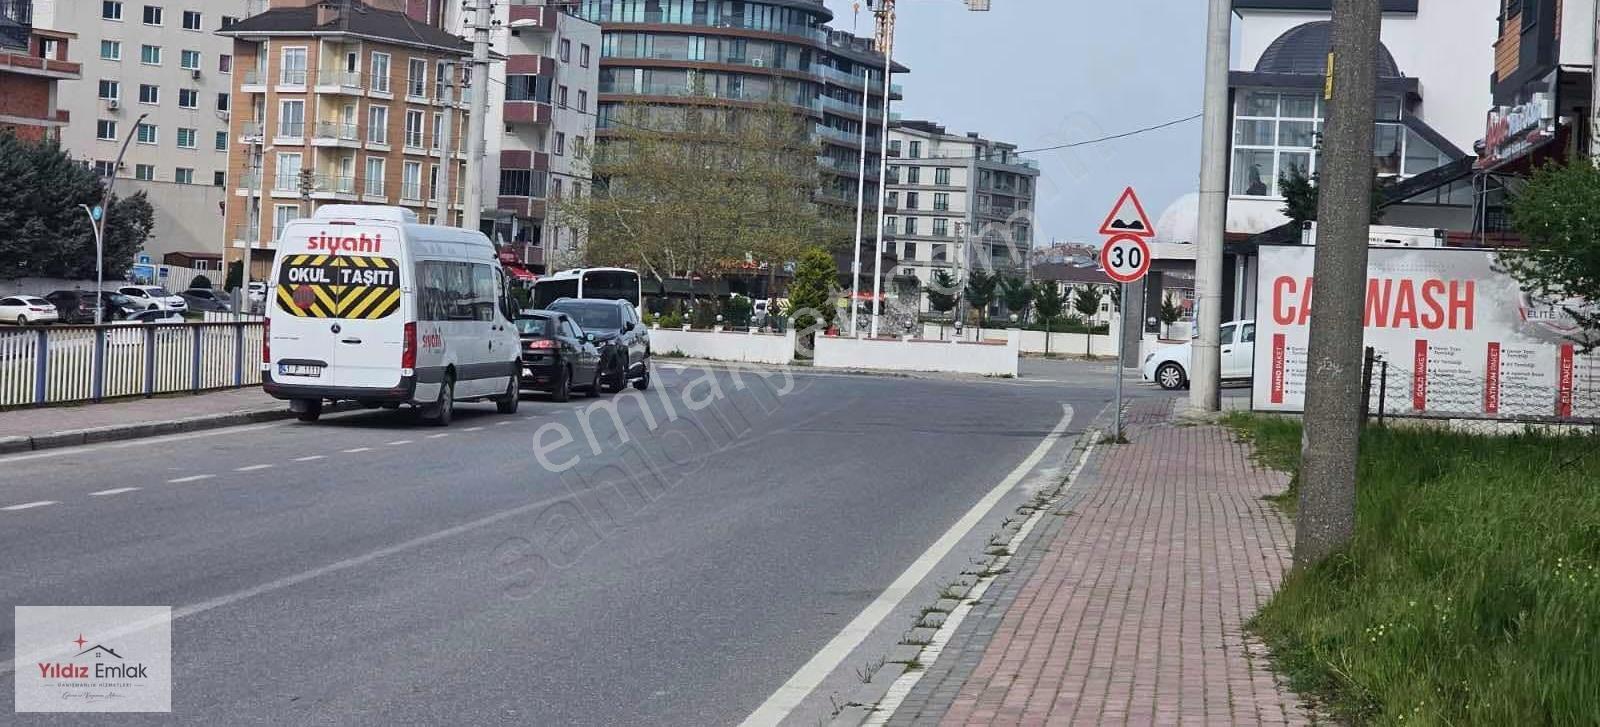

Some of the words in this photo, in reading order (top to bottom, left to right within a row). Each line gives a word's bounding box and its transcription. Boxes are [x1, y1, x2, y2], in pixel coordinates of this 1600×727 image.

[307, 231, 382, 255] siyahi
[1111, 246, 1141, 269] 30
[288, 267, 331, 283] OKUL
[340, 268, 395, 287] TAŞITI
[1272, 275, 1315, 326] CA
[1363, 277, 1475, 330] WASH
